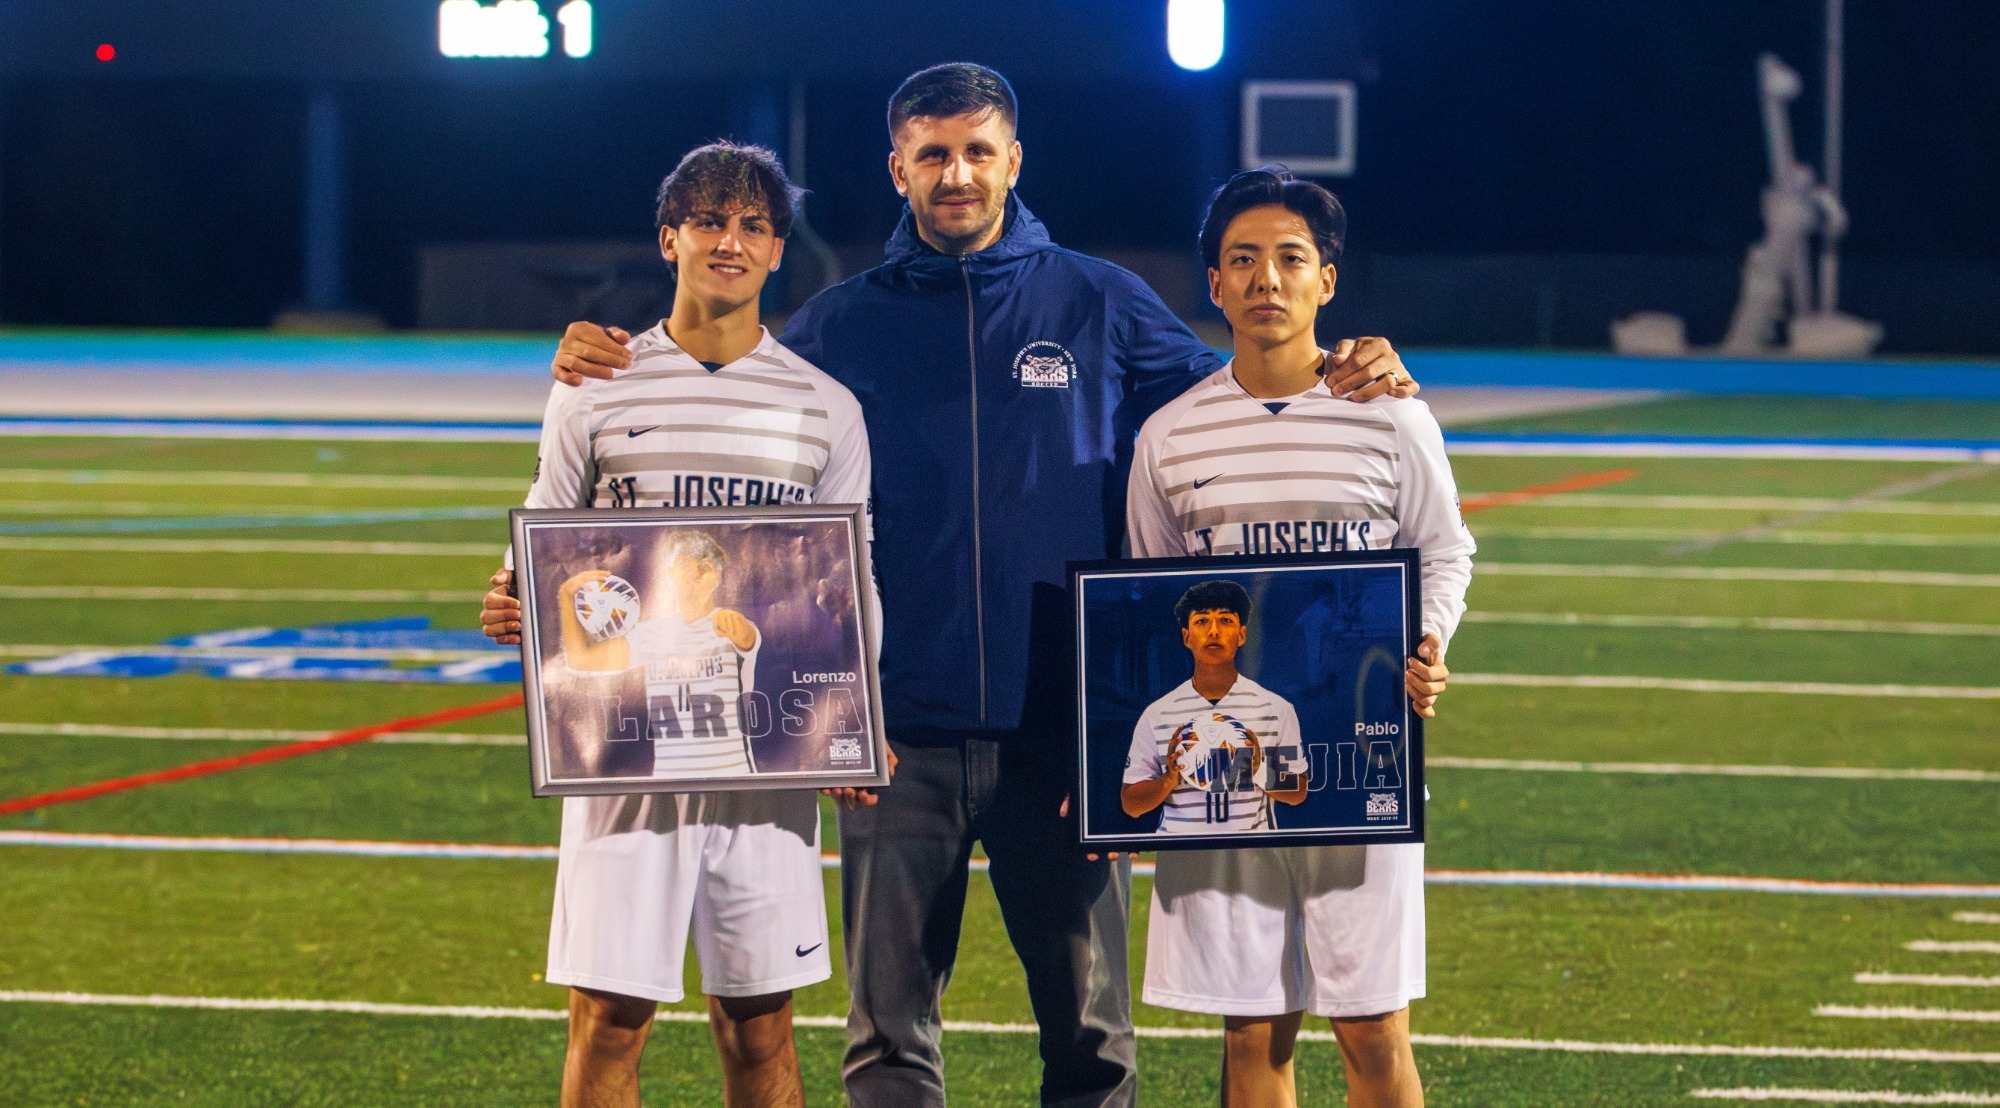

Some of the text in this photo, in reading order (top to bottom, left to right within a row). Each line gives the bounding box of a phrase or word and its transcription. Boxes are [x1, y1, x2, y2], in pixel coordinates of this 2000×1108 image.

[557, 0, 592, 58] 1
[1026, 340, 1062, 350] UNIVERSITY
[1063, 350, 1075, 362] NEW
[1070, 363, 1078, 379] YORK
[1021, 364, 1069, 382] BEARS
[1234, 521, 1371, 555] JOSEPH'S
[792, 671, 857, 684] Lorenzo
[602, 688, 863, 742] LAROSA
[1355, 722, 1399, 736] Pablo
[829, 745, 862, 758] BEARS
[1210, 741, 1402, 793] MEJIA
[1366, 800, 1399, 813] BEARS
